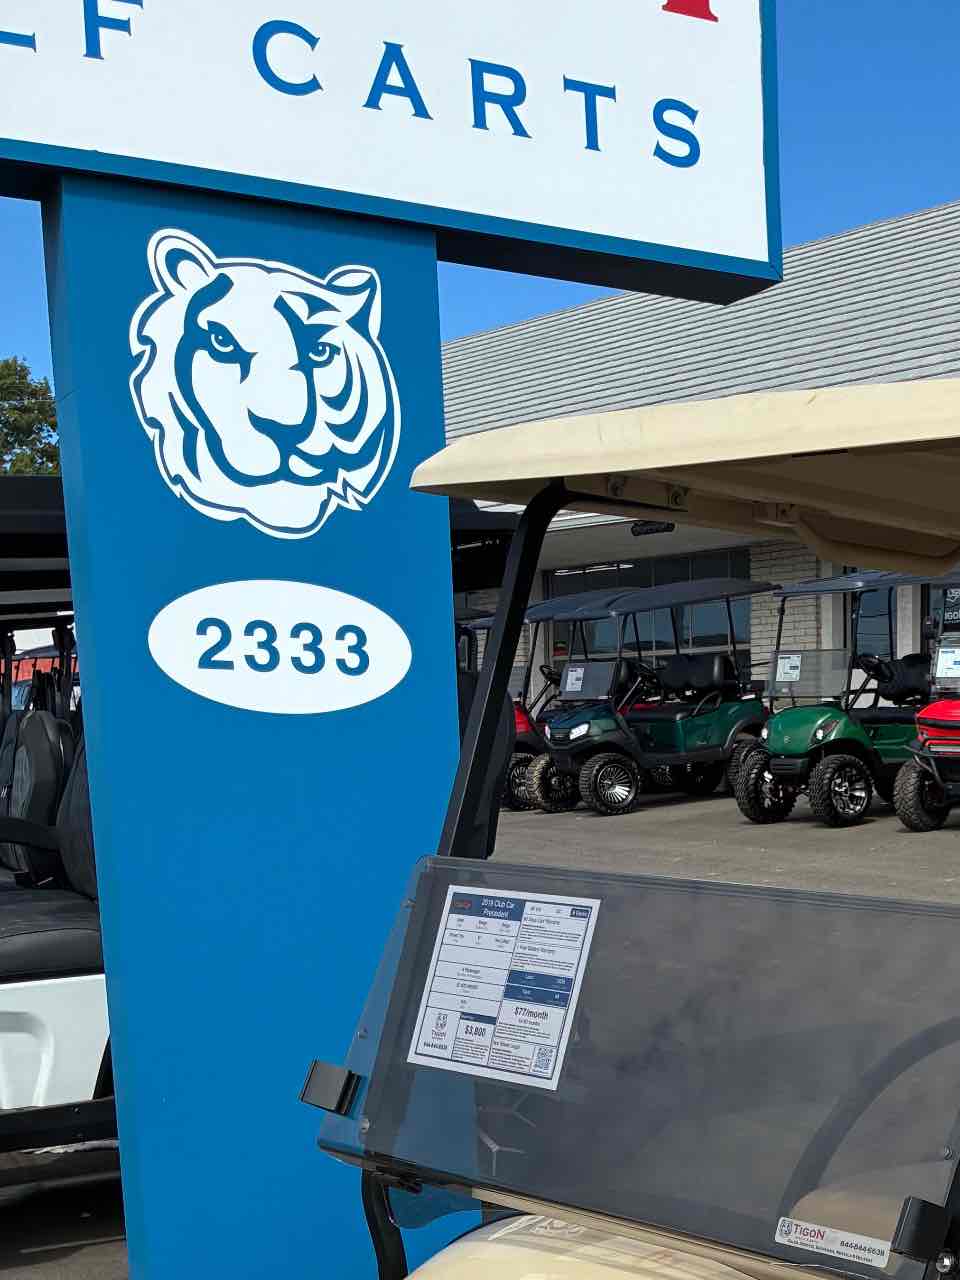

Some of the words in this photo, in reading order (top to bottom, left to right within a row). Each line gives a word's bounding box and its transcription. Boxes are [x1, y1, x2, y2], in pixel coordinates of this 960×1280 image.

[252, 19, 701, 169] CARTS
[196, 617, 370, 678] 2333
[794, 1224, 825, 1241] TIGON
